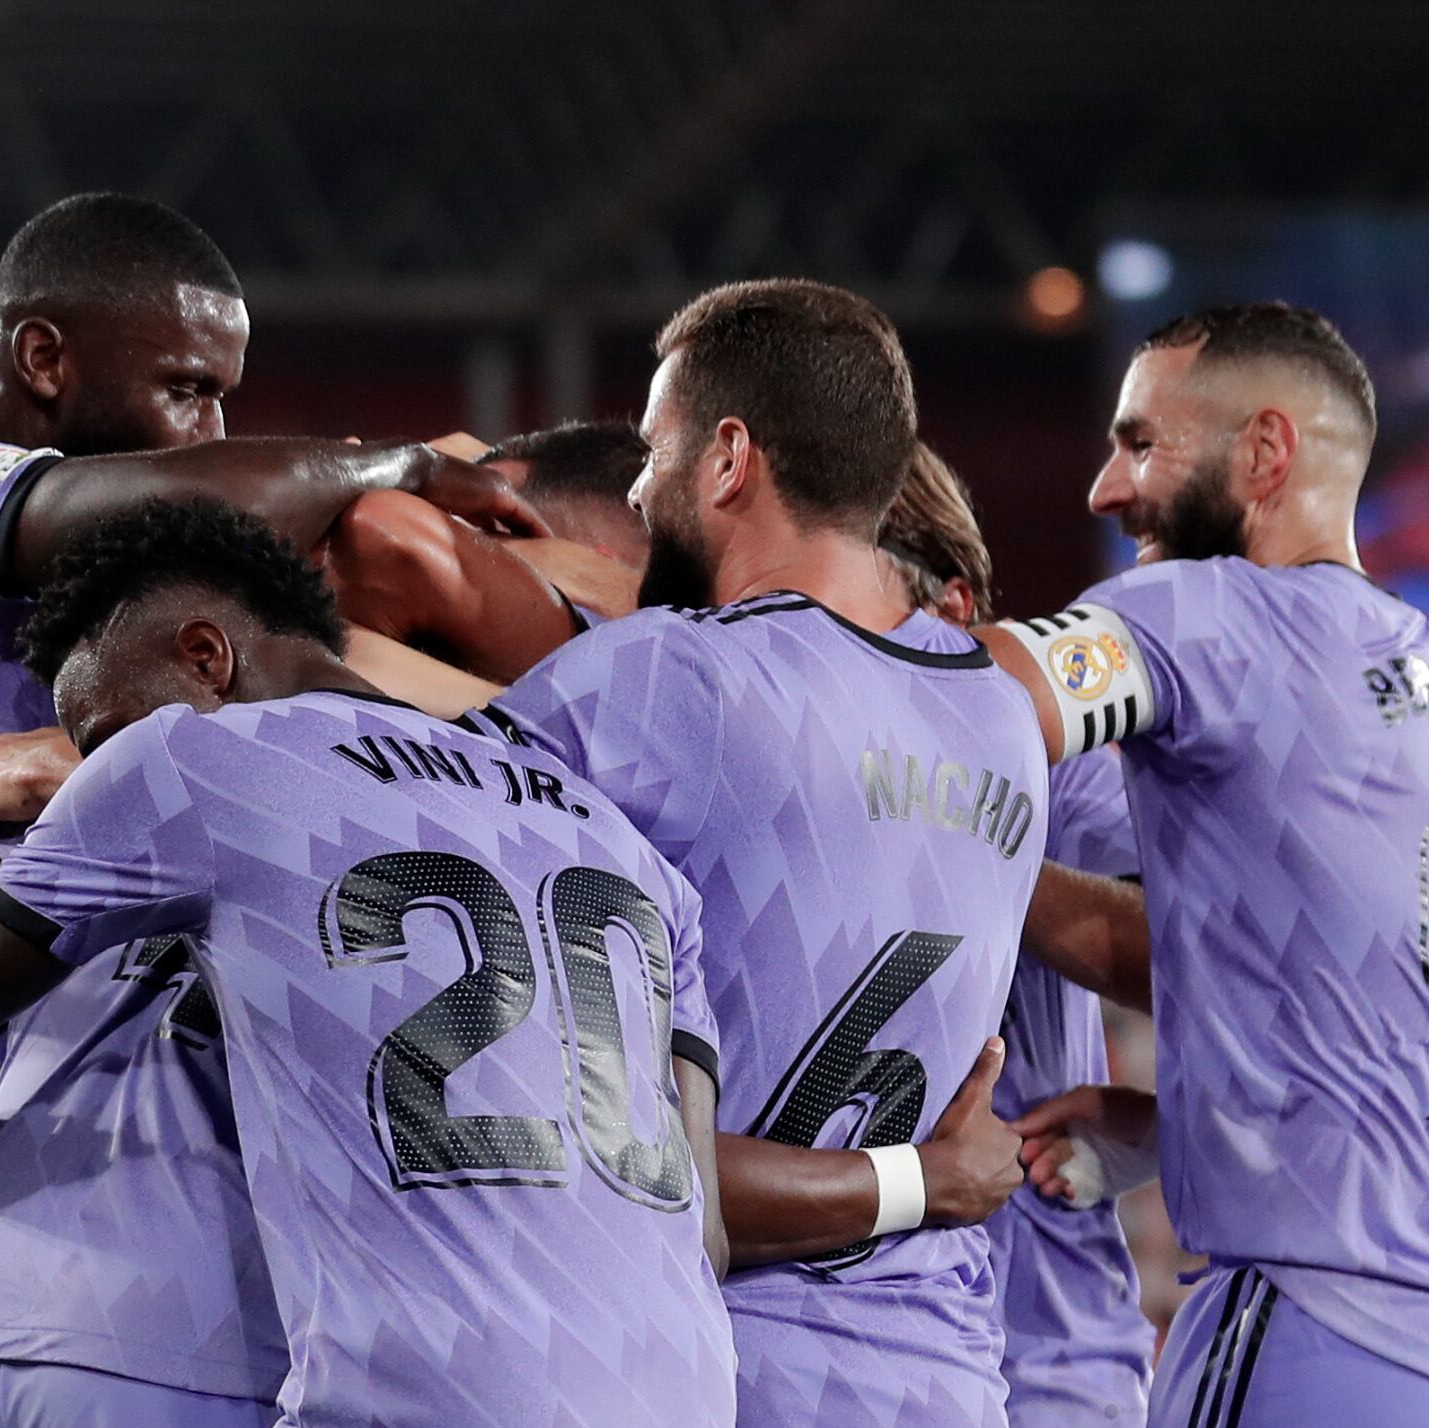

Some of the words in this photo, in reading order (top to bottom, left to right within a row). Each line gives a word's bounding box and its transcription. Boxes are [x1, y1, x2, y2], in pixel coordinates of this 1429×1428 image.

[330, 735, 484, 790] VINI
[490, 758, 590, 819] JR.
[860, 748, 1034, 860] NACHO
[318, 850, 692, 1214] 20
[747, 929, 965, 1273] 6
